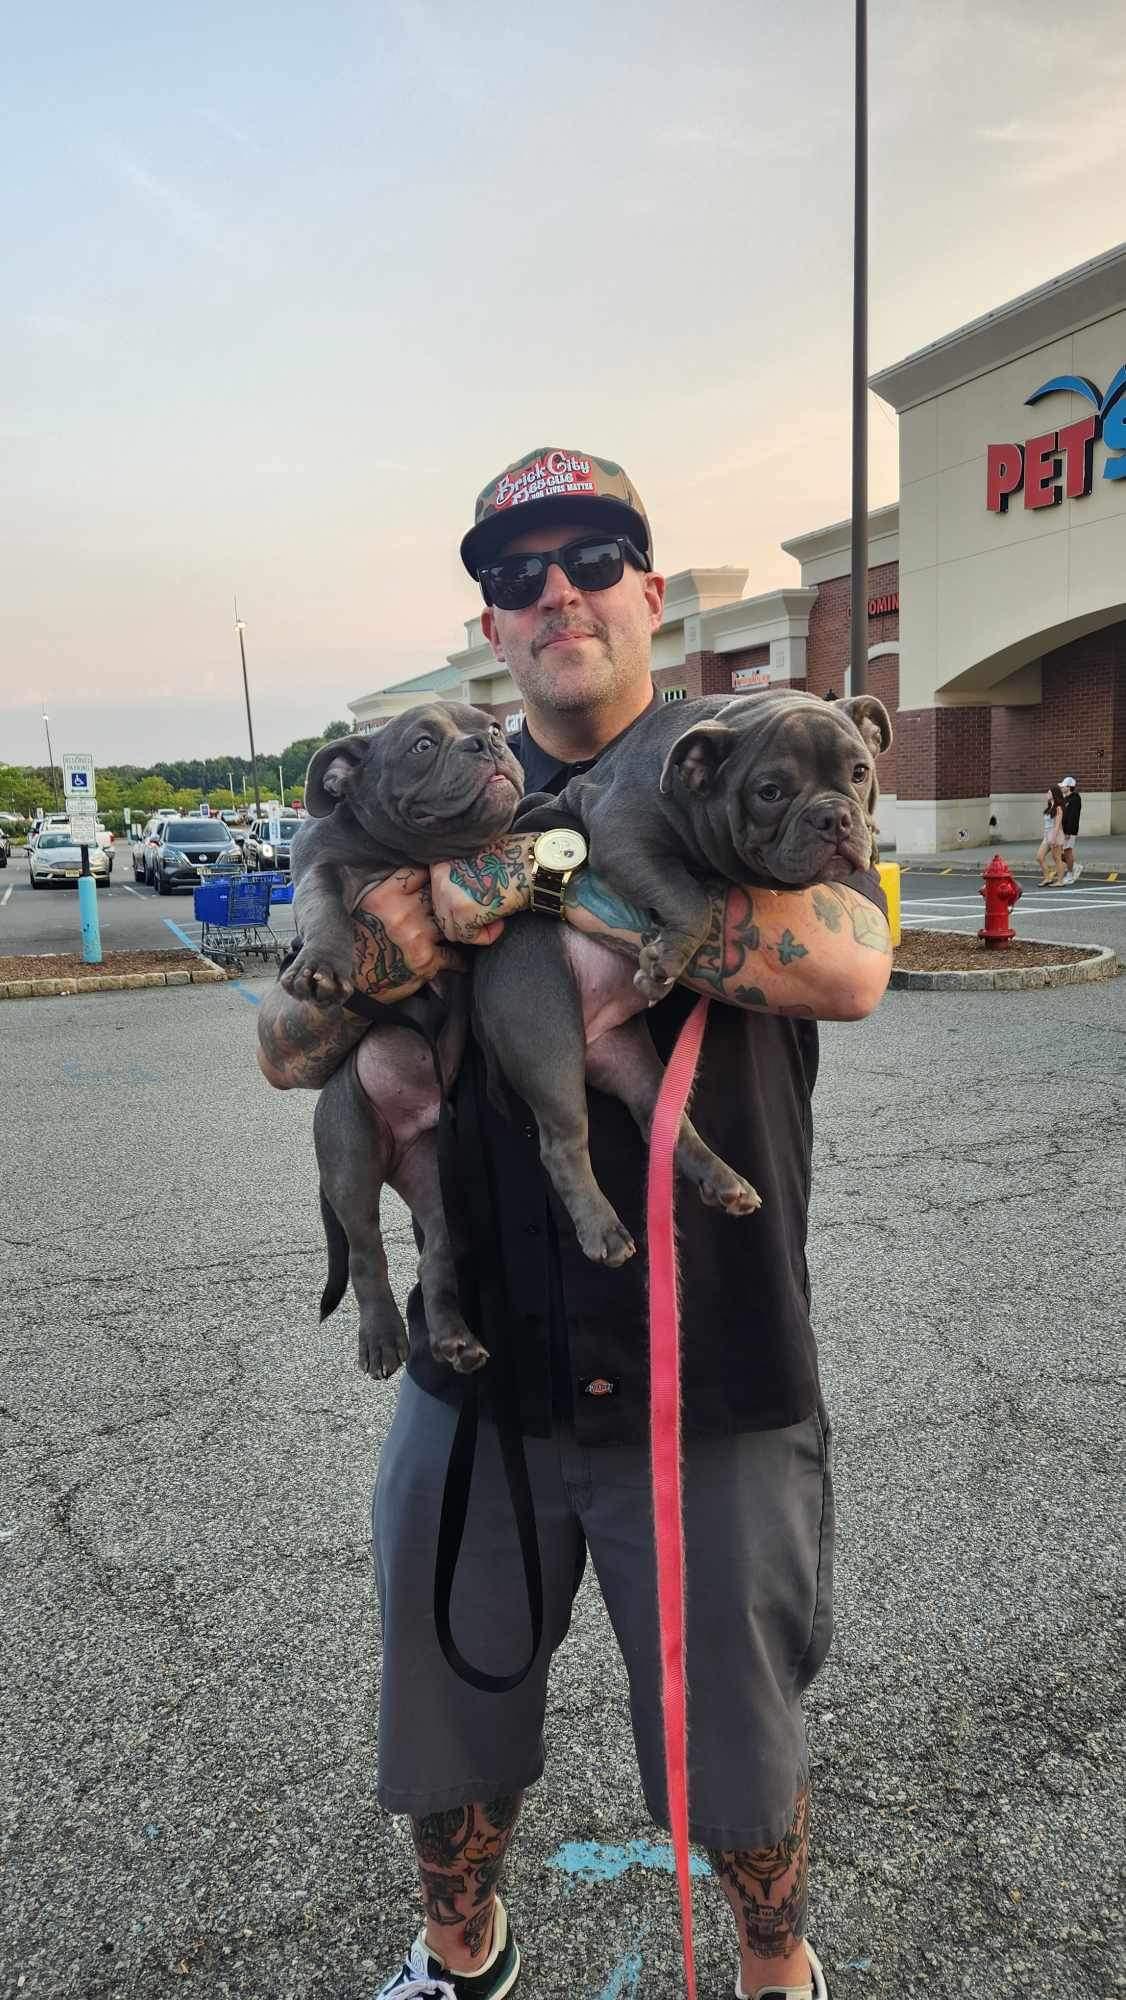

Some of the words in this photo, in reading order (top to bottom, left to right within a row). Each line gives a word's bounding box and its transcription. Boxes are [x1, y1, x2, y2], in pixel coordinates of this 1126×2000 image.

[496, 462, 545, 504] Brick
[547, 451, 590, 474] City
[567, 482, 593, 491] MATTER
[868, 592, 899, 615] OMIN
